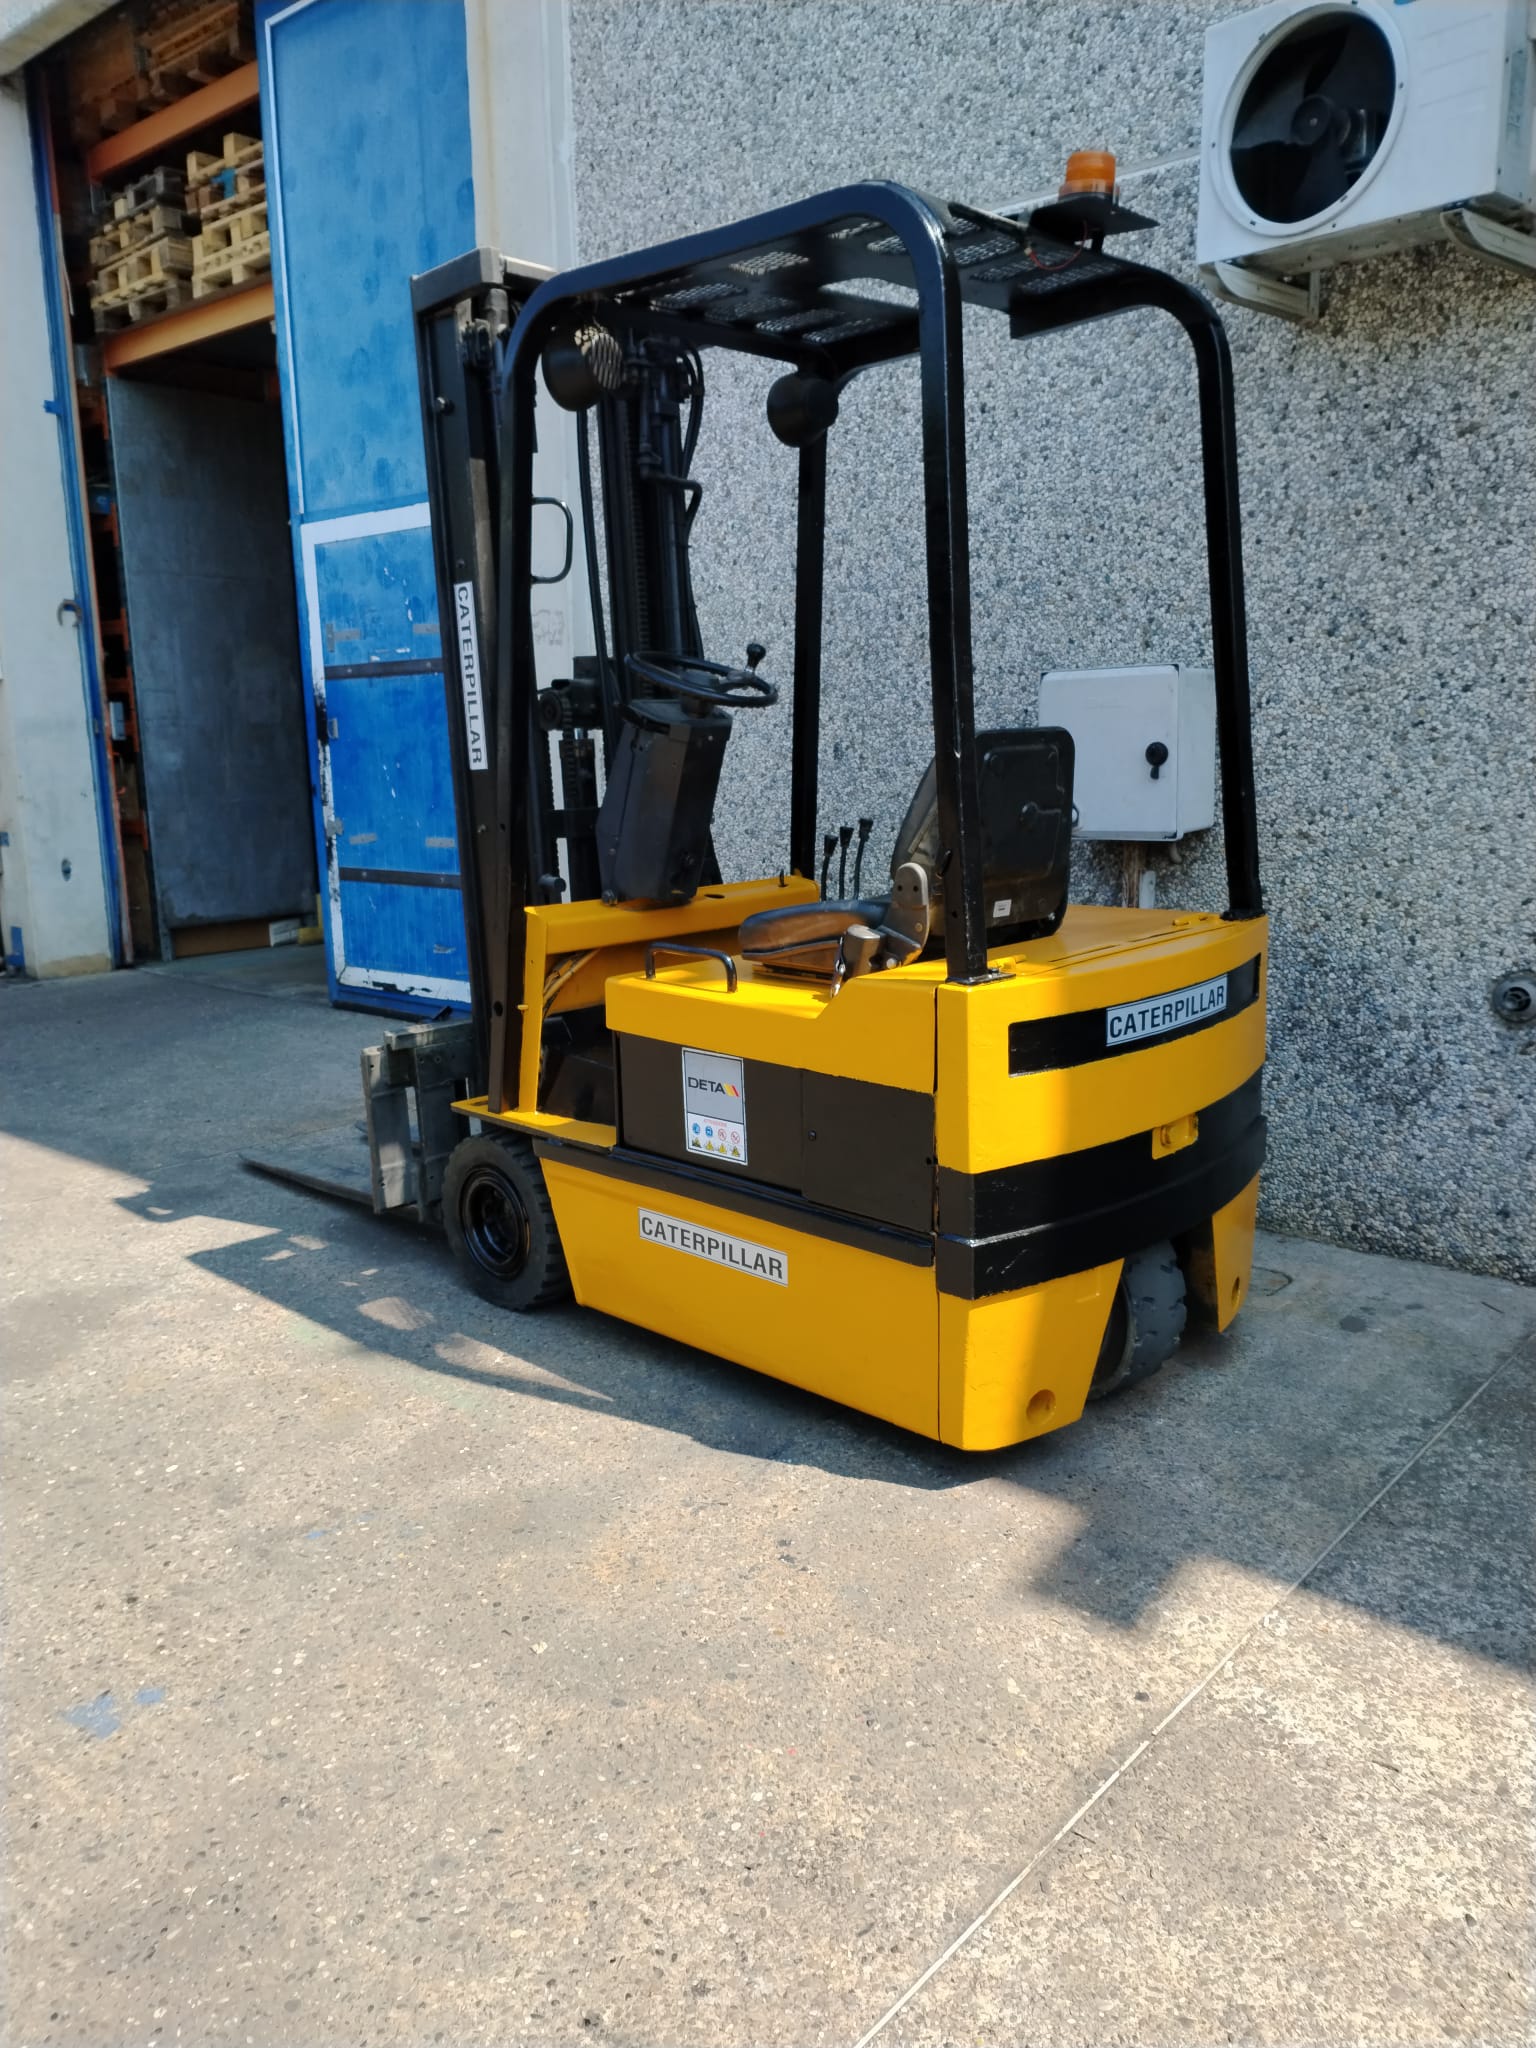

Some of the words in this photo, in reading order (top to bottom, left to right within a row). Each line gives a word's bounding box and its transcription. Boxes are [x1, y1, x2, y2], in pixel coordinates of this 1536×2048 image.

[457, 586, 482, 763] CATERPILLAR
[1110, 985, 1225, 1038] CATERPILLAR
[688, 1077, 725, 1095] DETA
[641, 1217, 783, 1279] CATERPILLAR
